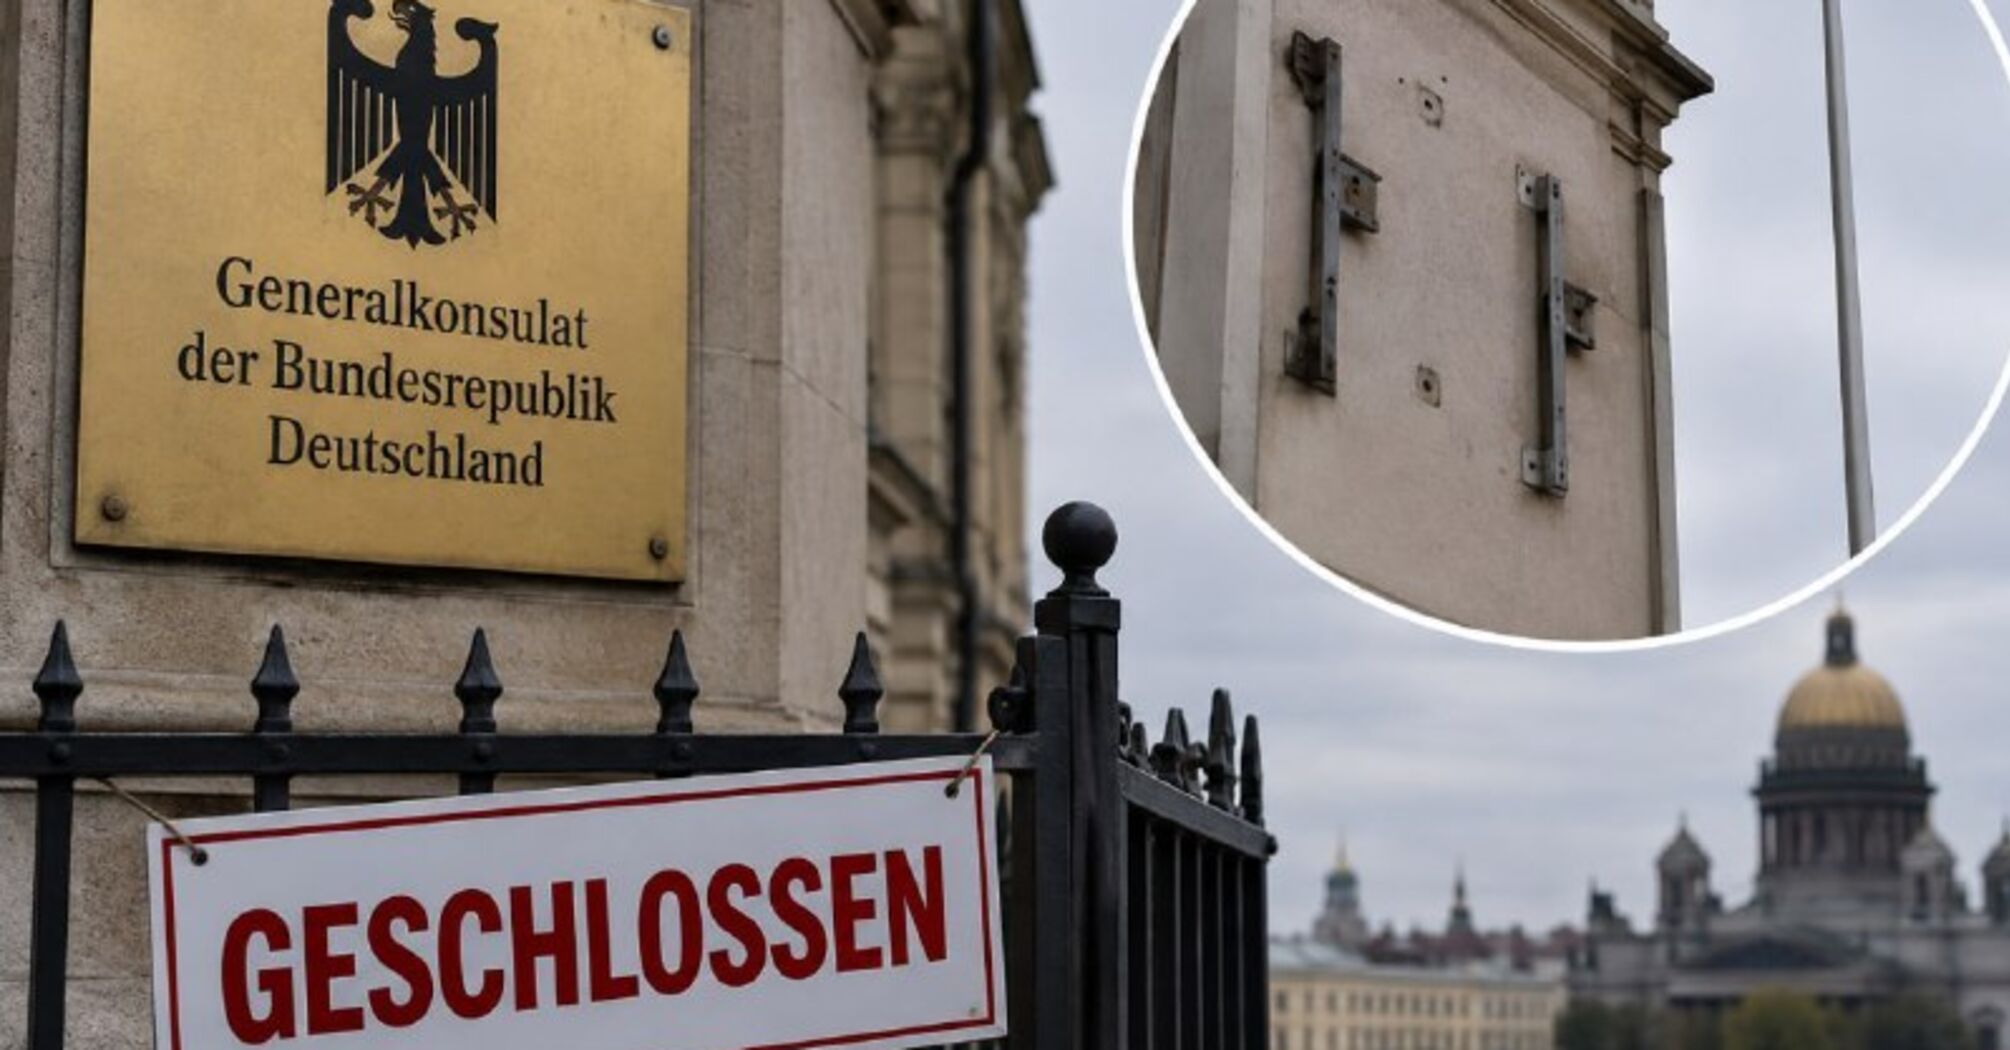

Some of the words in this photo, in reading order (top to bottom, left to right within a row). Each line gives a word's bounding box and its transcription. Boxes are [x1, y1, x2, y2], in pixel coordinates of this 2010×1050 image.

[216, 256, 589, 350] Generalkonsulat
[177, 331, 259, 386] der
[271, 339, 618, 426] Bundesrepublik
[267, 415, 545, 487] Deutschland
[221, 846, 948, 1044] GESCHLOSSEN
